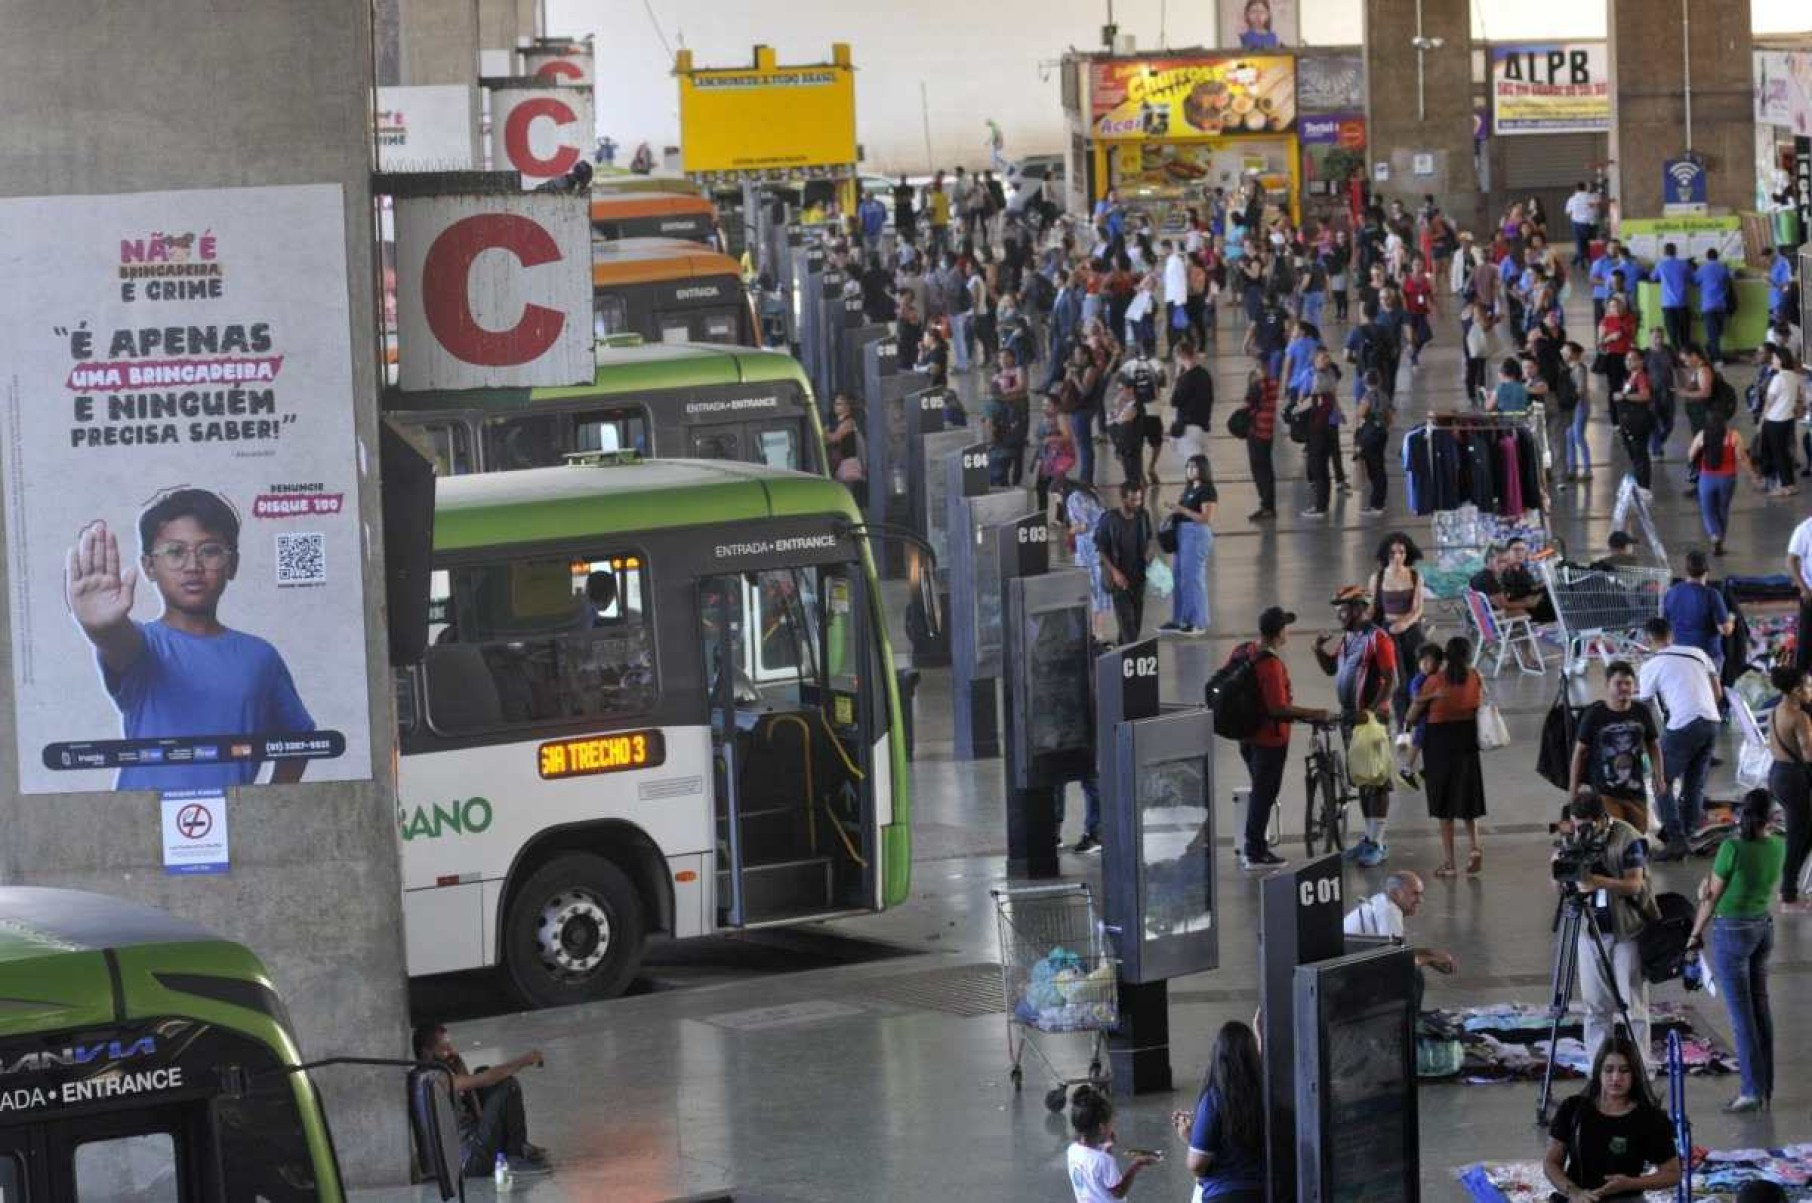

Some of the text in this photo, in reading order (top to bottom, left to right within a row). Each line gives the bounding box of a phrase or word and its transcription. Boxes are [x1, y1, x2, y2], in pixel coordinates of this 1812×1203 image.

[1504, 50, 1590, 85] ALPB
[505, 97, 580, 178] C
[199, 228, 217, 260] É
[145, 278, 223, 301] CRIME
[422, 212, 566, 368] C
[676, 286, 719, 300] ENTRADA
[108, 322, 273, 360] APENAS
[71, 361, 274, 387] UMA BRINCADEIRA
[108, 384, 276, 422] NINGUÉM
[731, 396, 778, 411] ENTRANCE
[920, 396, 943, 410] C 05
[71, 424, 180, 448] PRECISA
[964, 452, 989, 469] C 04
[257, 498, 339, 513] DISQUE 100
[715, 535, 837, 558] ENTRADA ENTRANCE
[1018, 526, 1047, 543] C 03
[1123, 656, 1158, 678] C 02
[568, 737, 632, 771] TRECHO
[633, 734, 647, 763] 3
[1300, 876, 1342, 907] C 01
[61, 1066, 184, 1103] ENTRANCE
